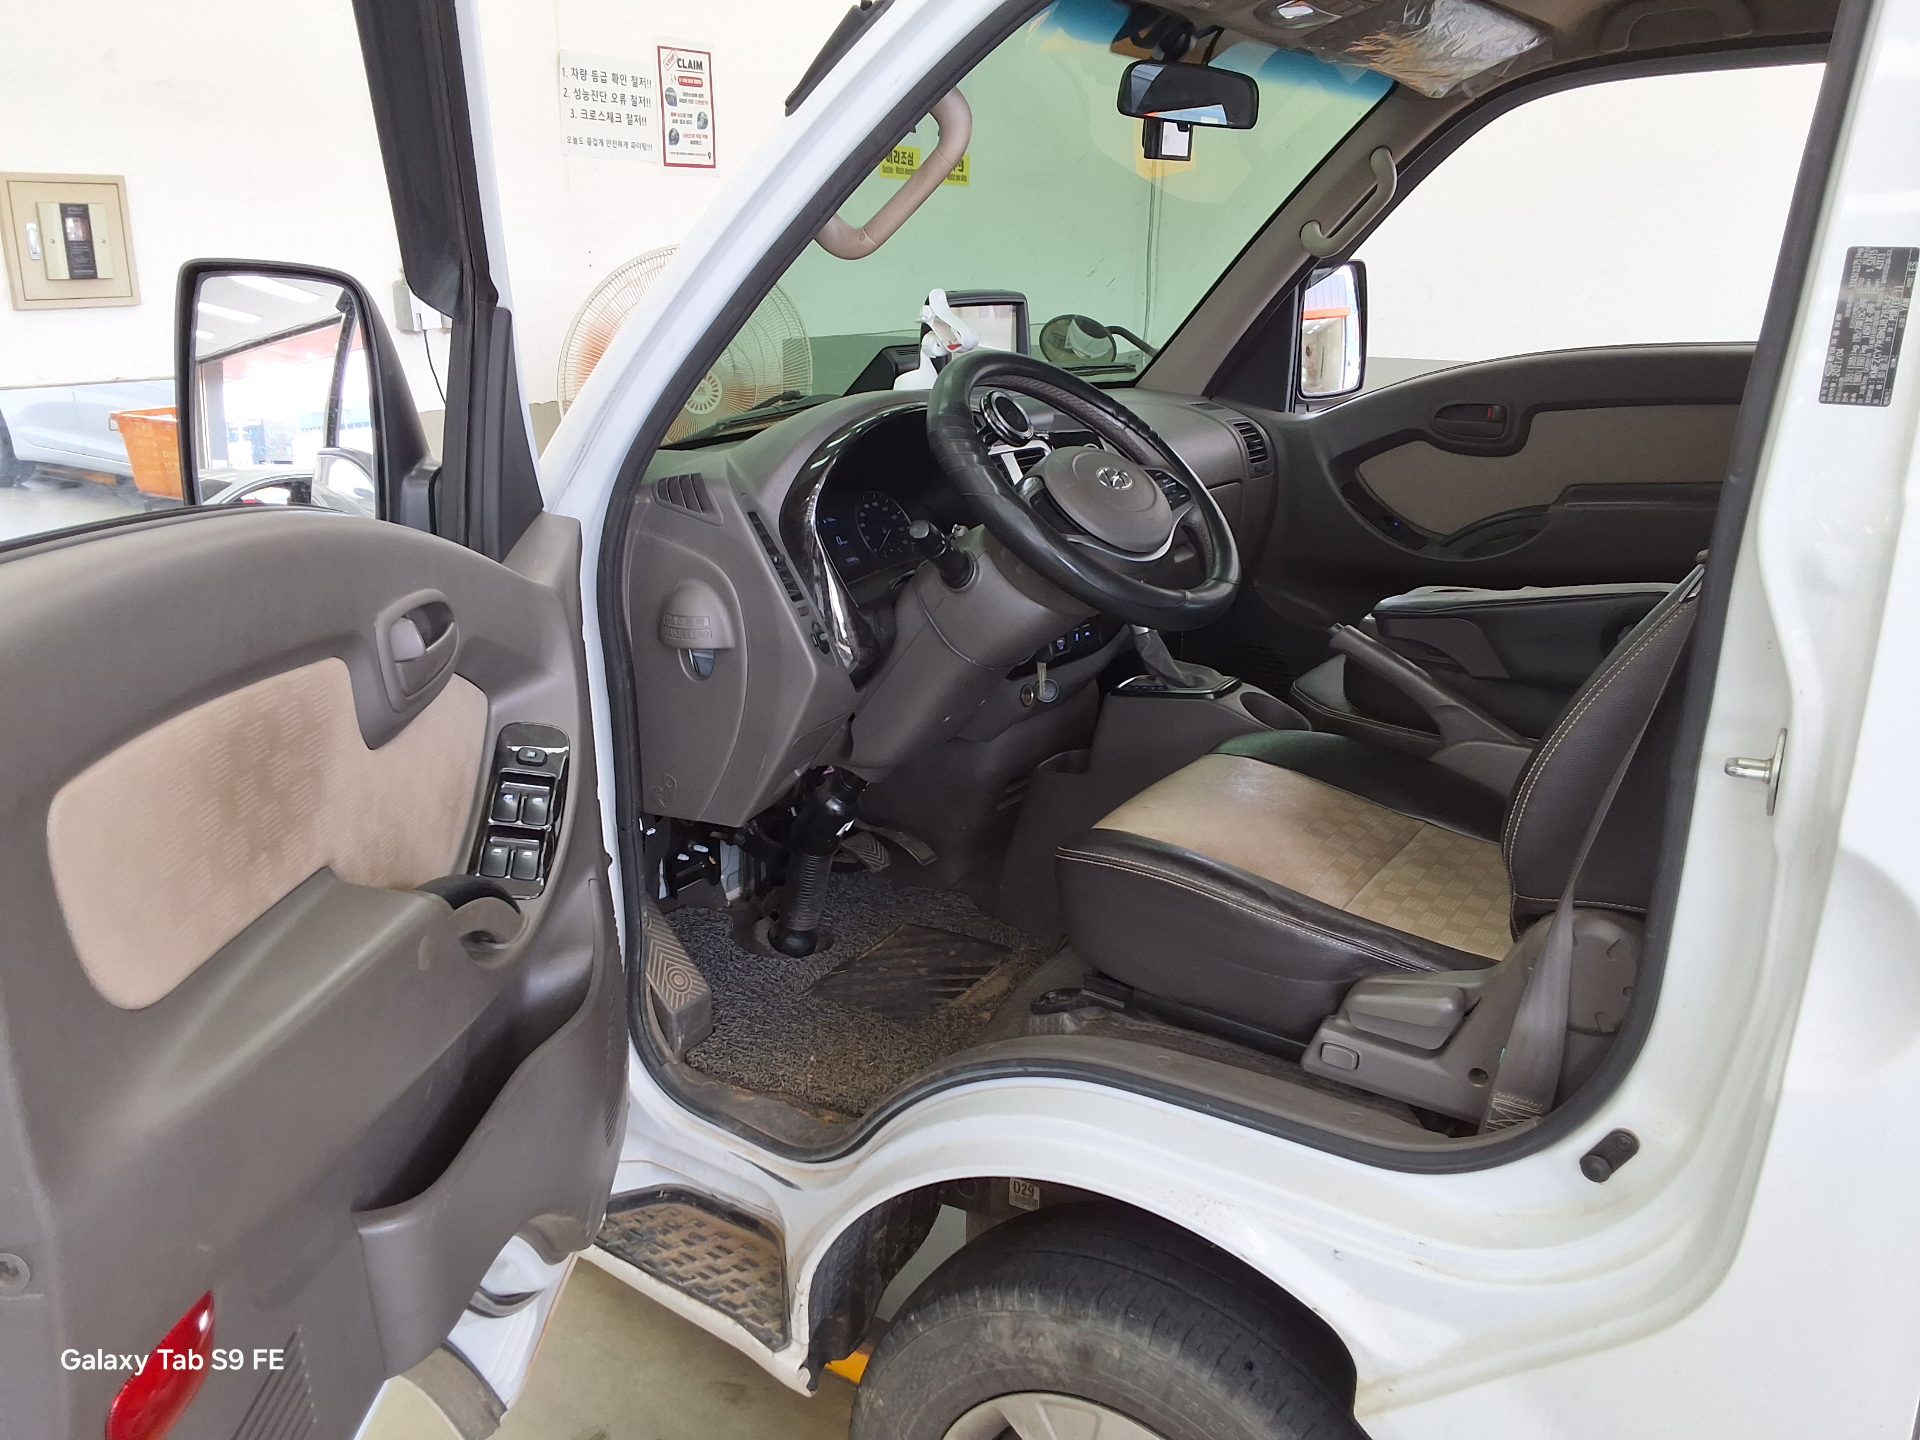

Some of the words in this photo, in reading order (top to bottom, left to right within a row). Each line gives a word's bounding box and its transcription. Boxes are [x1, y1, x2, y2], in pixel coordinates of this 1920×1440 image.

[677, 58, 703, 70] CLAIM
[562, 67, 568, 78] 1.
[571, 67, 588, 81] 차량
[591, 70, 607, 84] 등급
[612, 72, 627, 86] 확인
[630, 75, 652, 88] 철저!!
[564, 88, 570, 98] 2.
[574, 88, 607, 103] 성능진단
[611, 93, 626, 106] 오류
[630, 94, 651, 108] 철저!!
[570, 108, 578, 118] 3.
[580, 108, 622, 123] 크로스체크
[626, 114, 646, 126] 철저!!
[566, 136, 584, 144] 오늘도
[606, 139, 628, 149] 안전하게
[1014, 1180, 1034, 1198] D29
